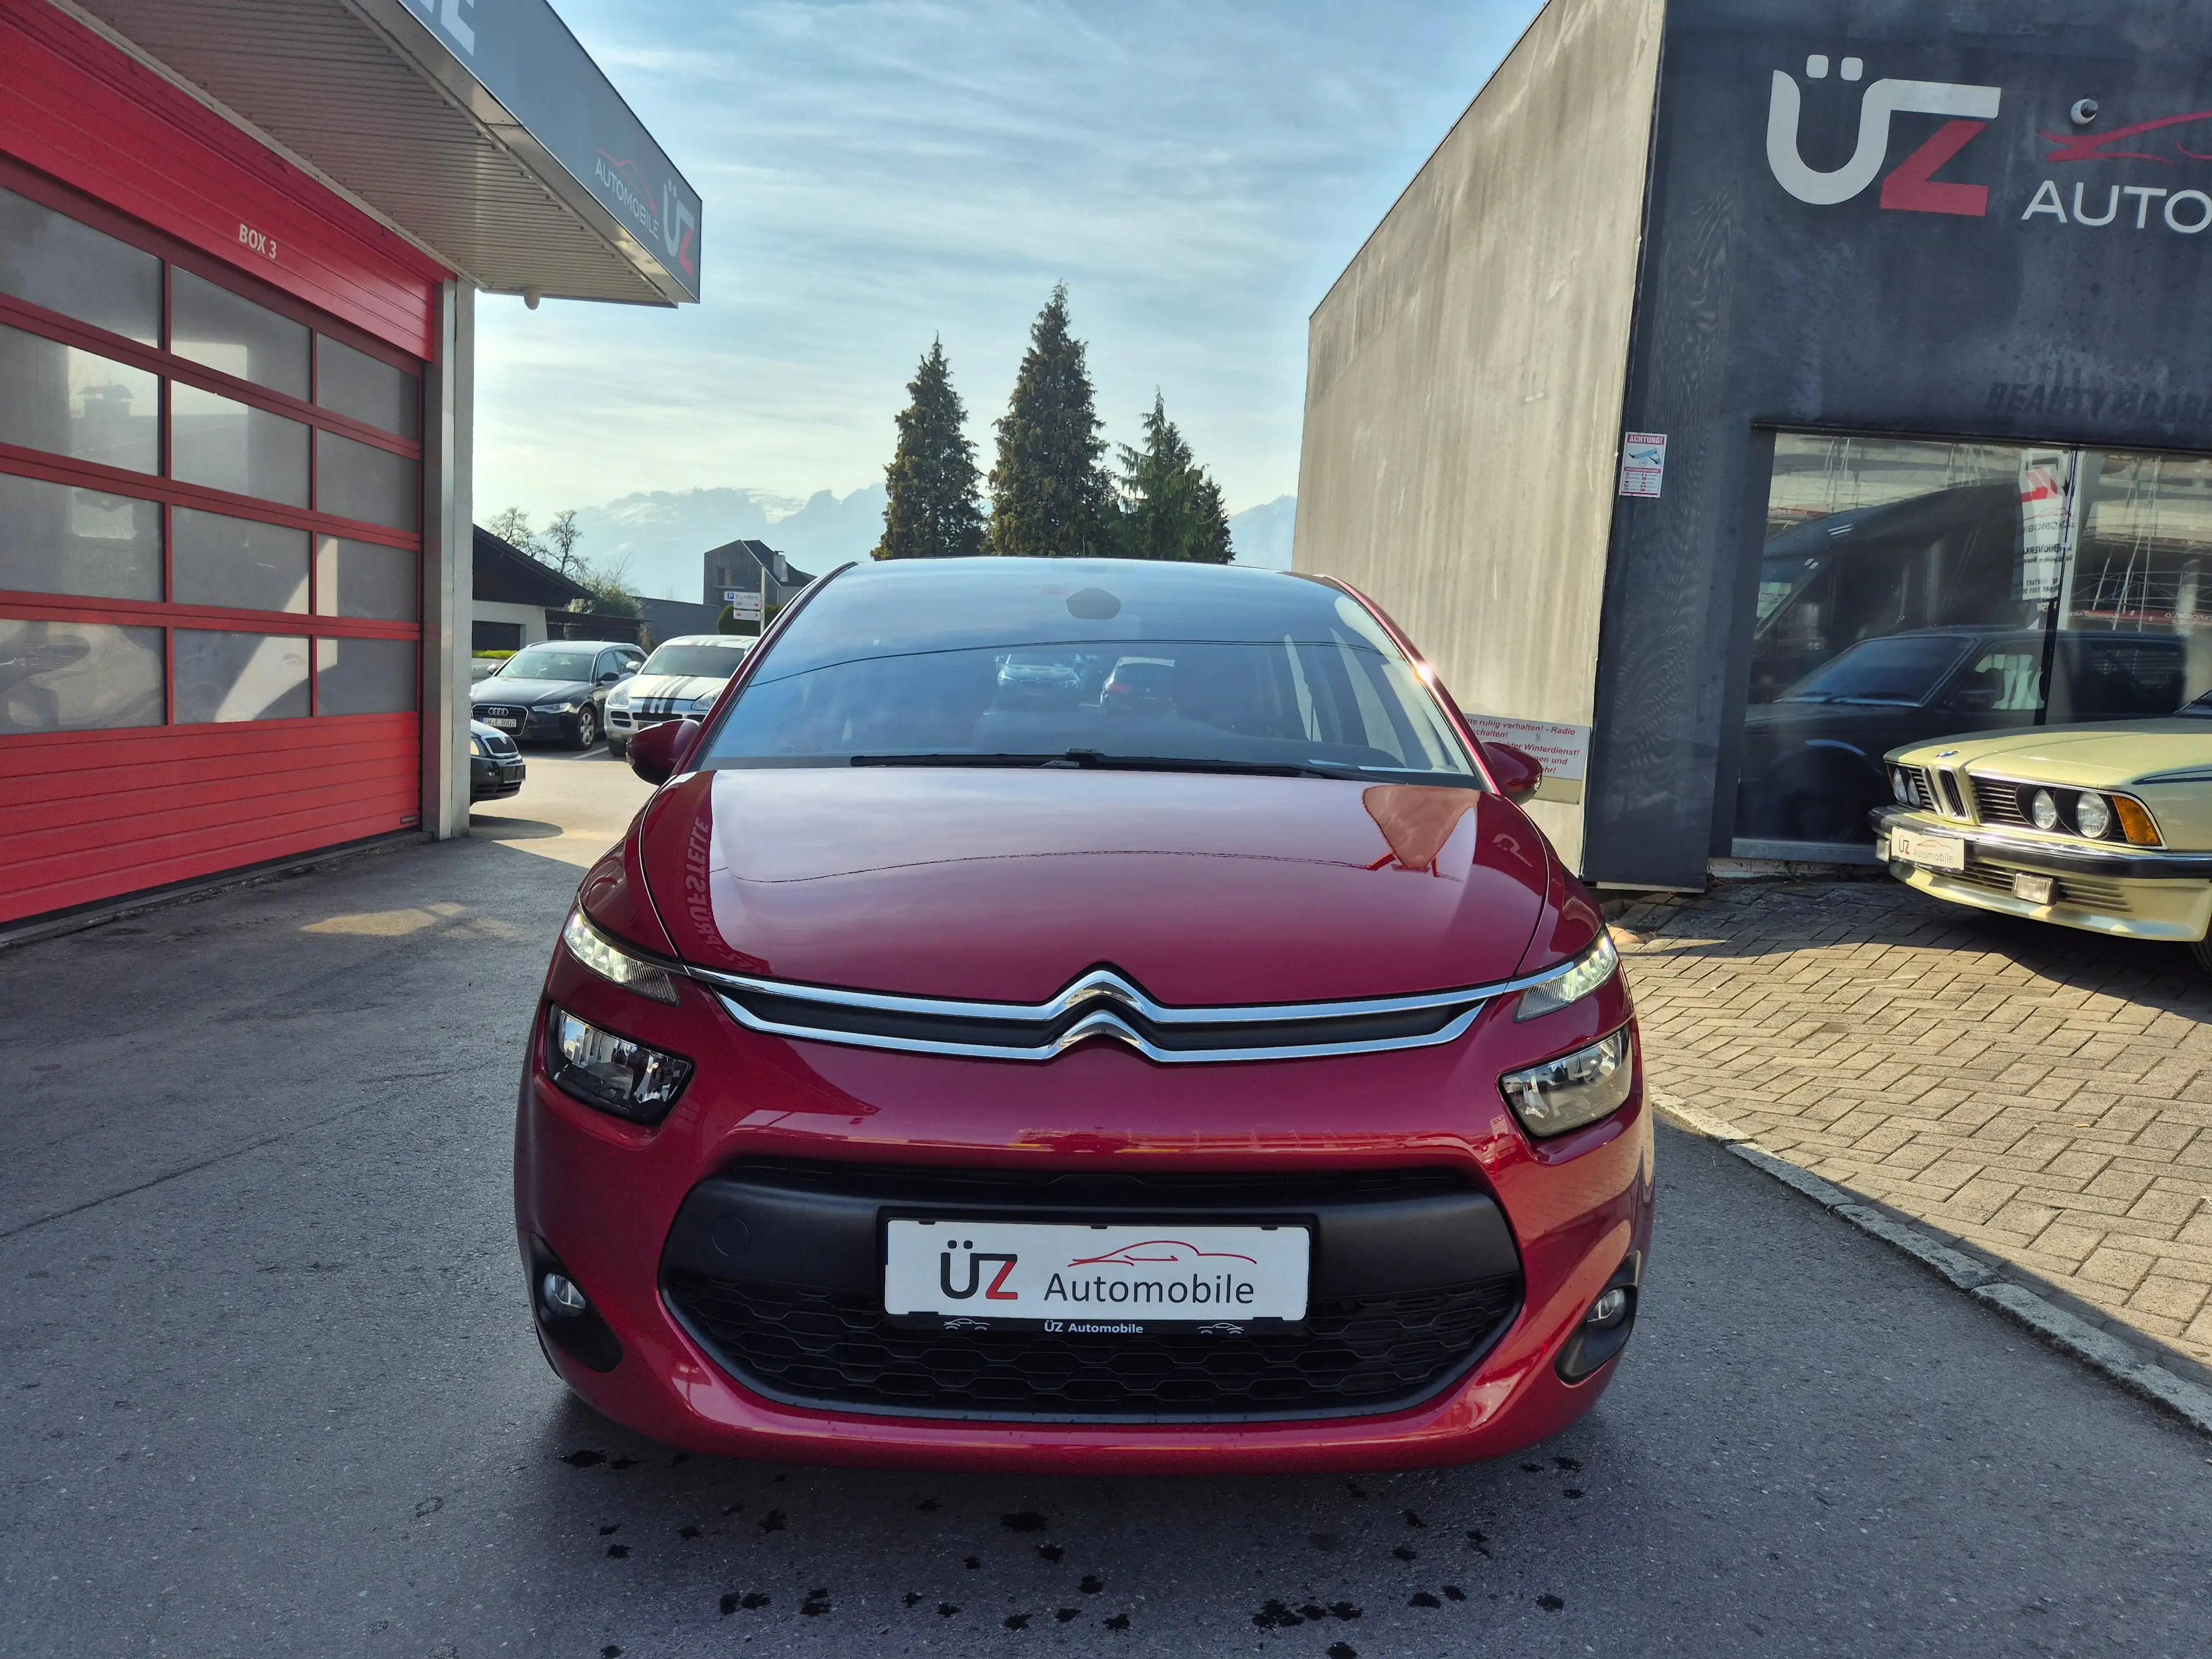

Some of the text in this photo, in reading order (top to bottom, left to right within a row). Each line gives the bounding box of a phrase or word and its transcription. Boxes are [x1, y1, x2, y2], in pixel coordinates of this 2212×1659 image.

[1766, 55, 2001, 216] ÜZ
[595, 158, 660, 240] AUTOMOBILE
[2021, 180, 2212, 233] AUTO
[239, 223, 276, 259] BOX 3
[664, 178, 695, 277] ÜZ
[1628, 435, 1663, 444] ACHTUNG!
[1465, 717, 1478, 726] itte
[1479, 720, 1501, 729] ruhig
[1503, 723, 1544, 732] verhalten!
[1551, 726, 1575, 736] Radio
[1524, 744, 1580, 756] Winterdienst!
[1899, 835, 1910, 855] ÜZ
[1913, 847, 1953, 863] Automobile
[941, 1240, 1018, 1300] ÜZ
[1044, 1273, 1254, 1304] Automobile
[1044, 1320, 1143, 1334] ÜZ Automobile
